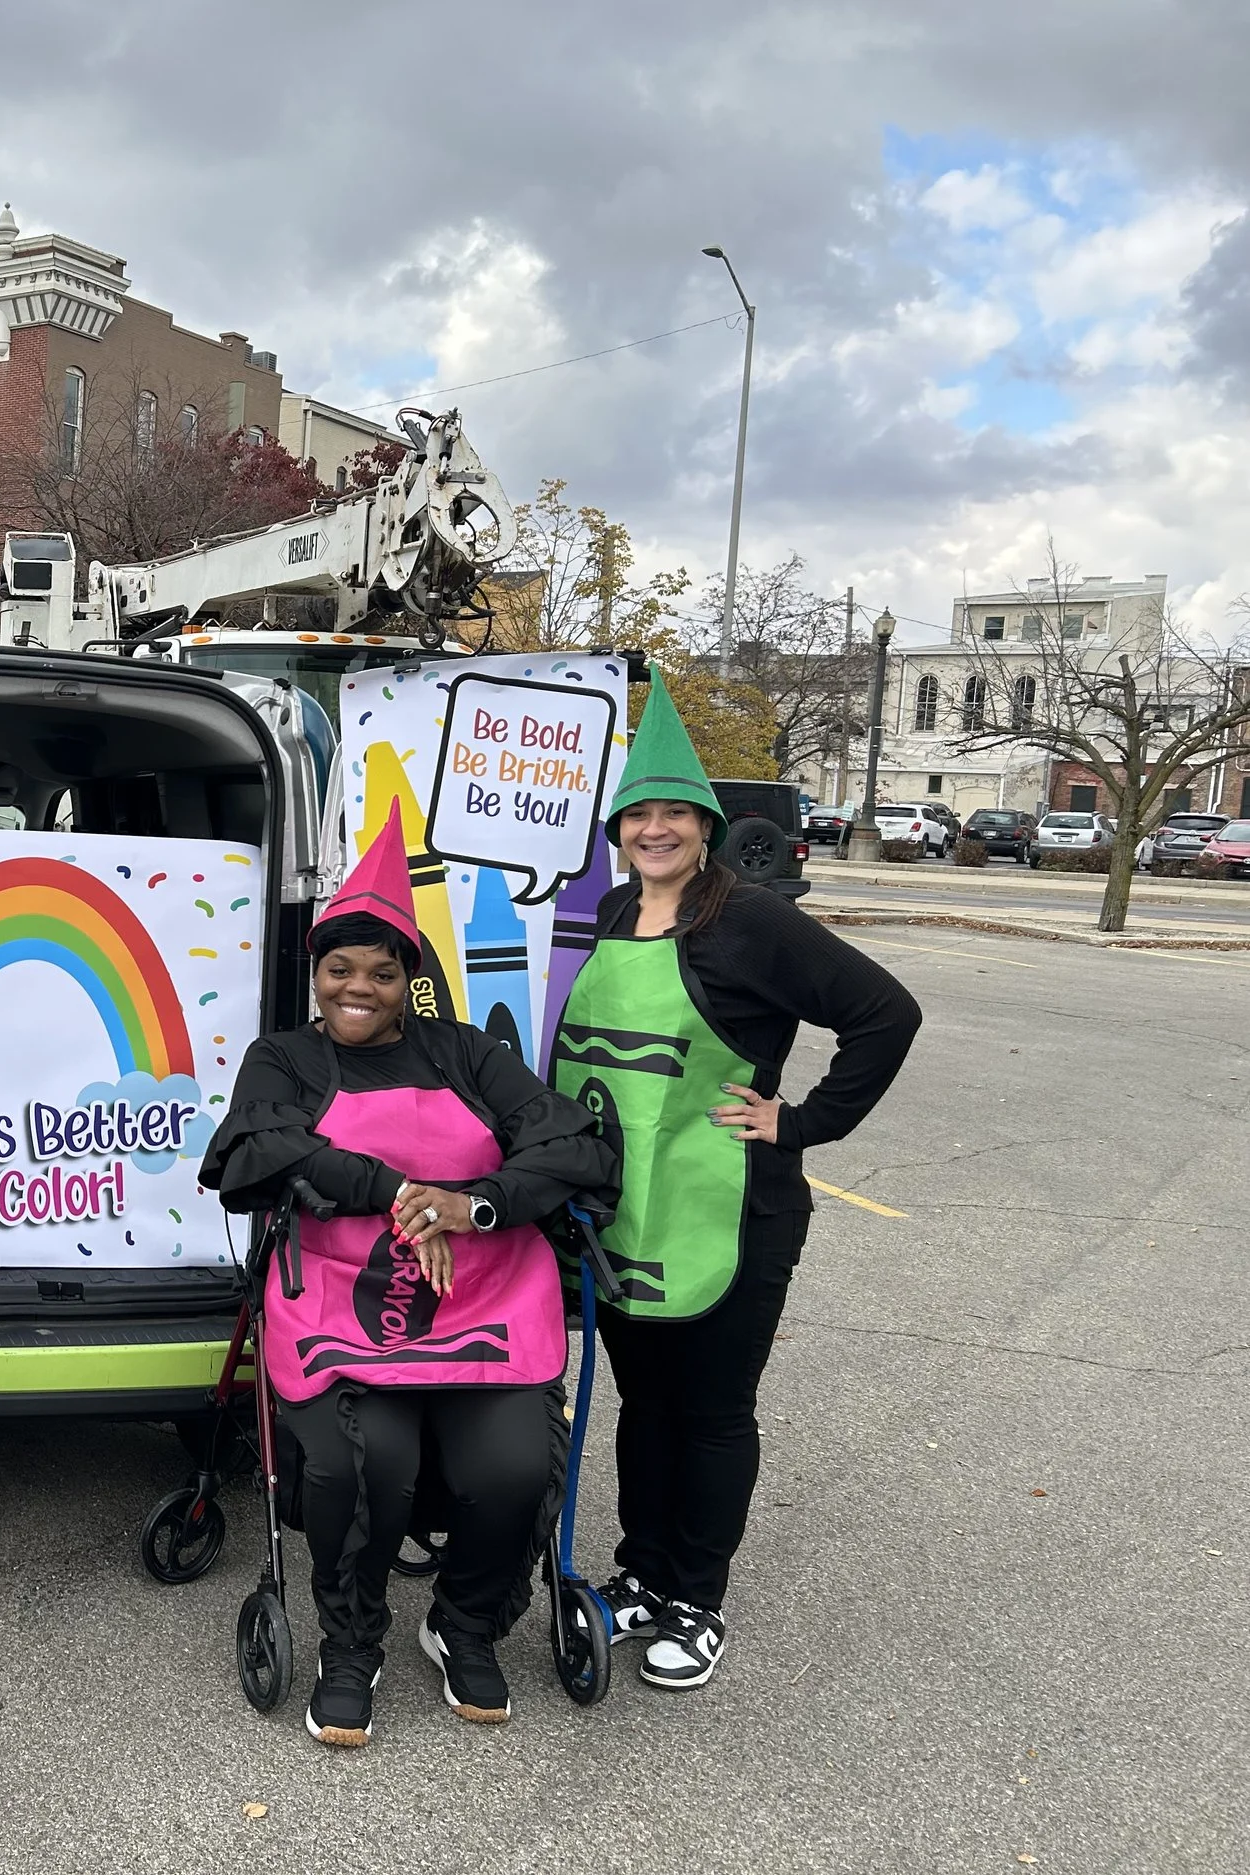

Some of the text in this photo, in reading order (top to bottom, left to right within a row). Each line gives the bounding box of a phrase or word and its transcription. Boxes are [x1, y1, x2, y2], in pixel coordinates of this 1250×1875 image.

[288, 532, 319, 565] VERSALIFT
[474, 708, 583, 754] Be Bold.
[453, 742, 592, 794] Be Bright.
[466, 782, 570, 827] Be You!
[33, 1101, 196, 1156] Better
